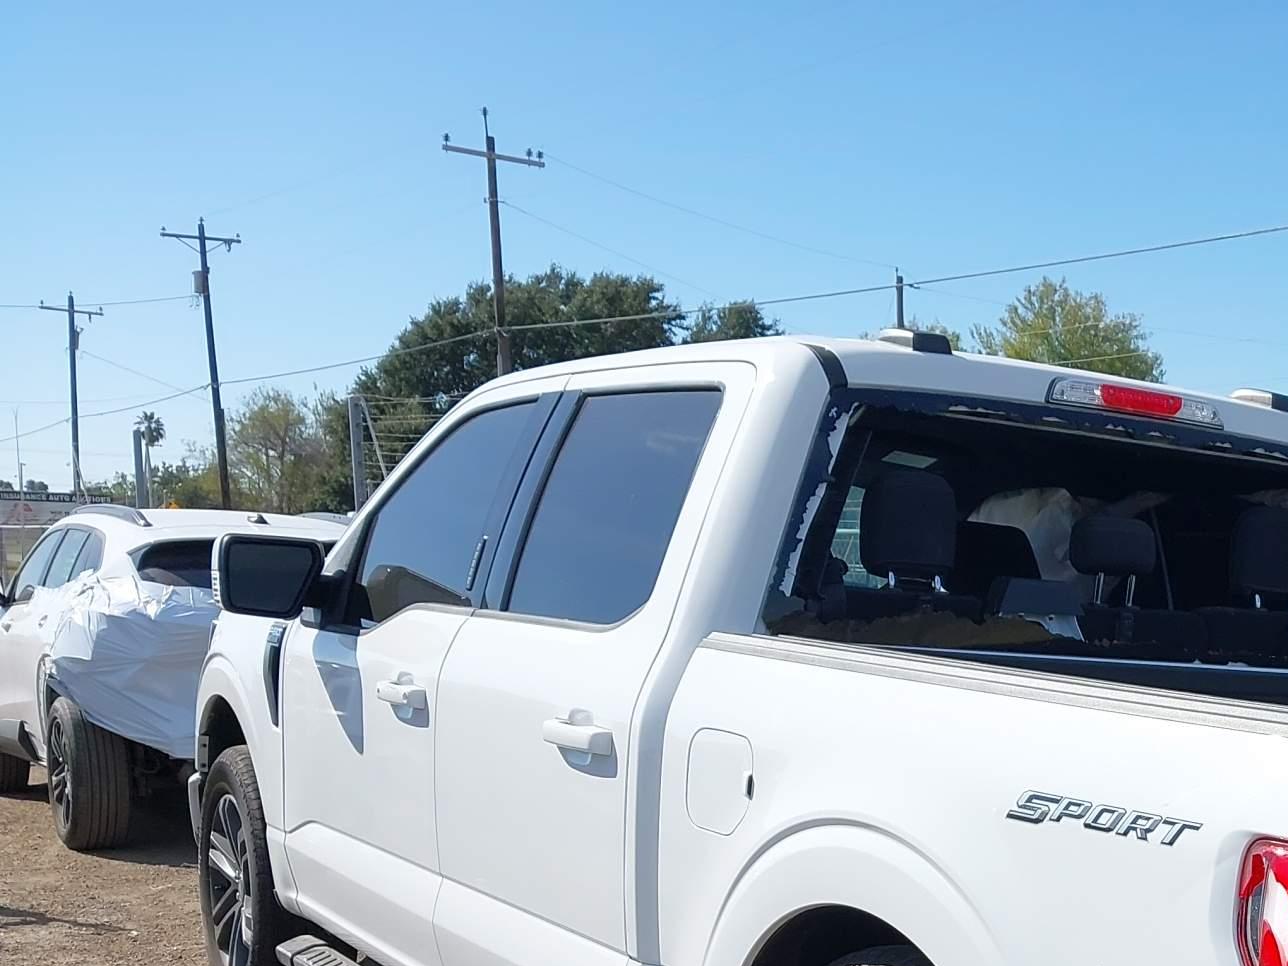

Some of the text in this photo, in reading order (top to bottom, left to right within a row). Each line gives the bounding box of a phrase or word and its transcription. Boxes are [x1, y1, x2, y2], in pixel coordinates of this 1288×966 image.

[0, 492, 47, 501] INSUANCE
[71, 495, 111, 504] ATIONS
[1006, 790, 1203, 846] SPORT
